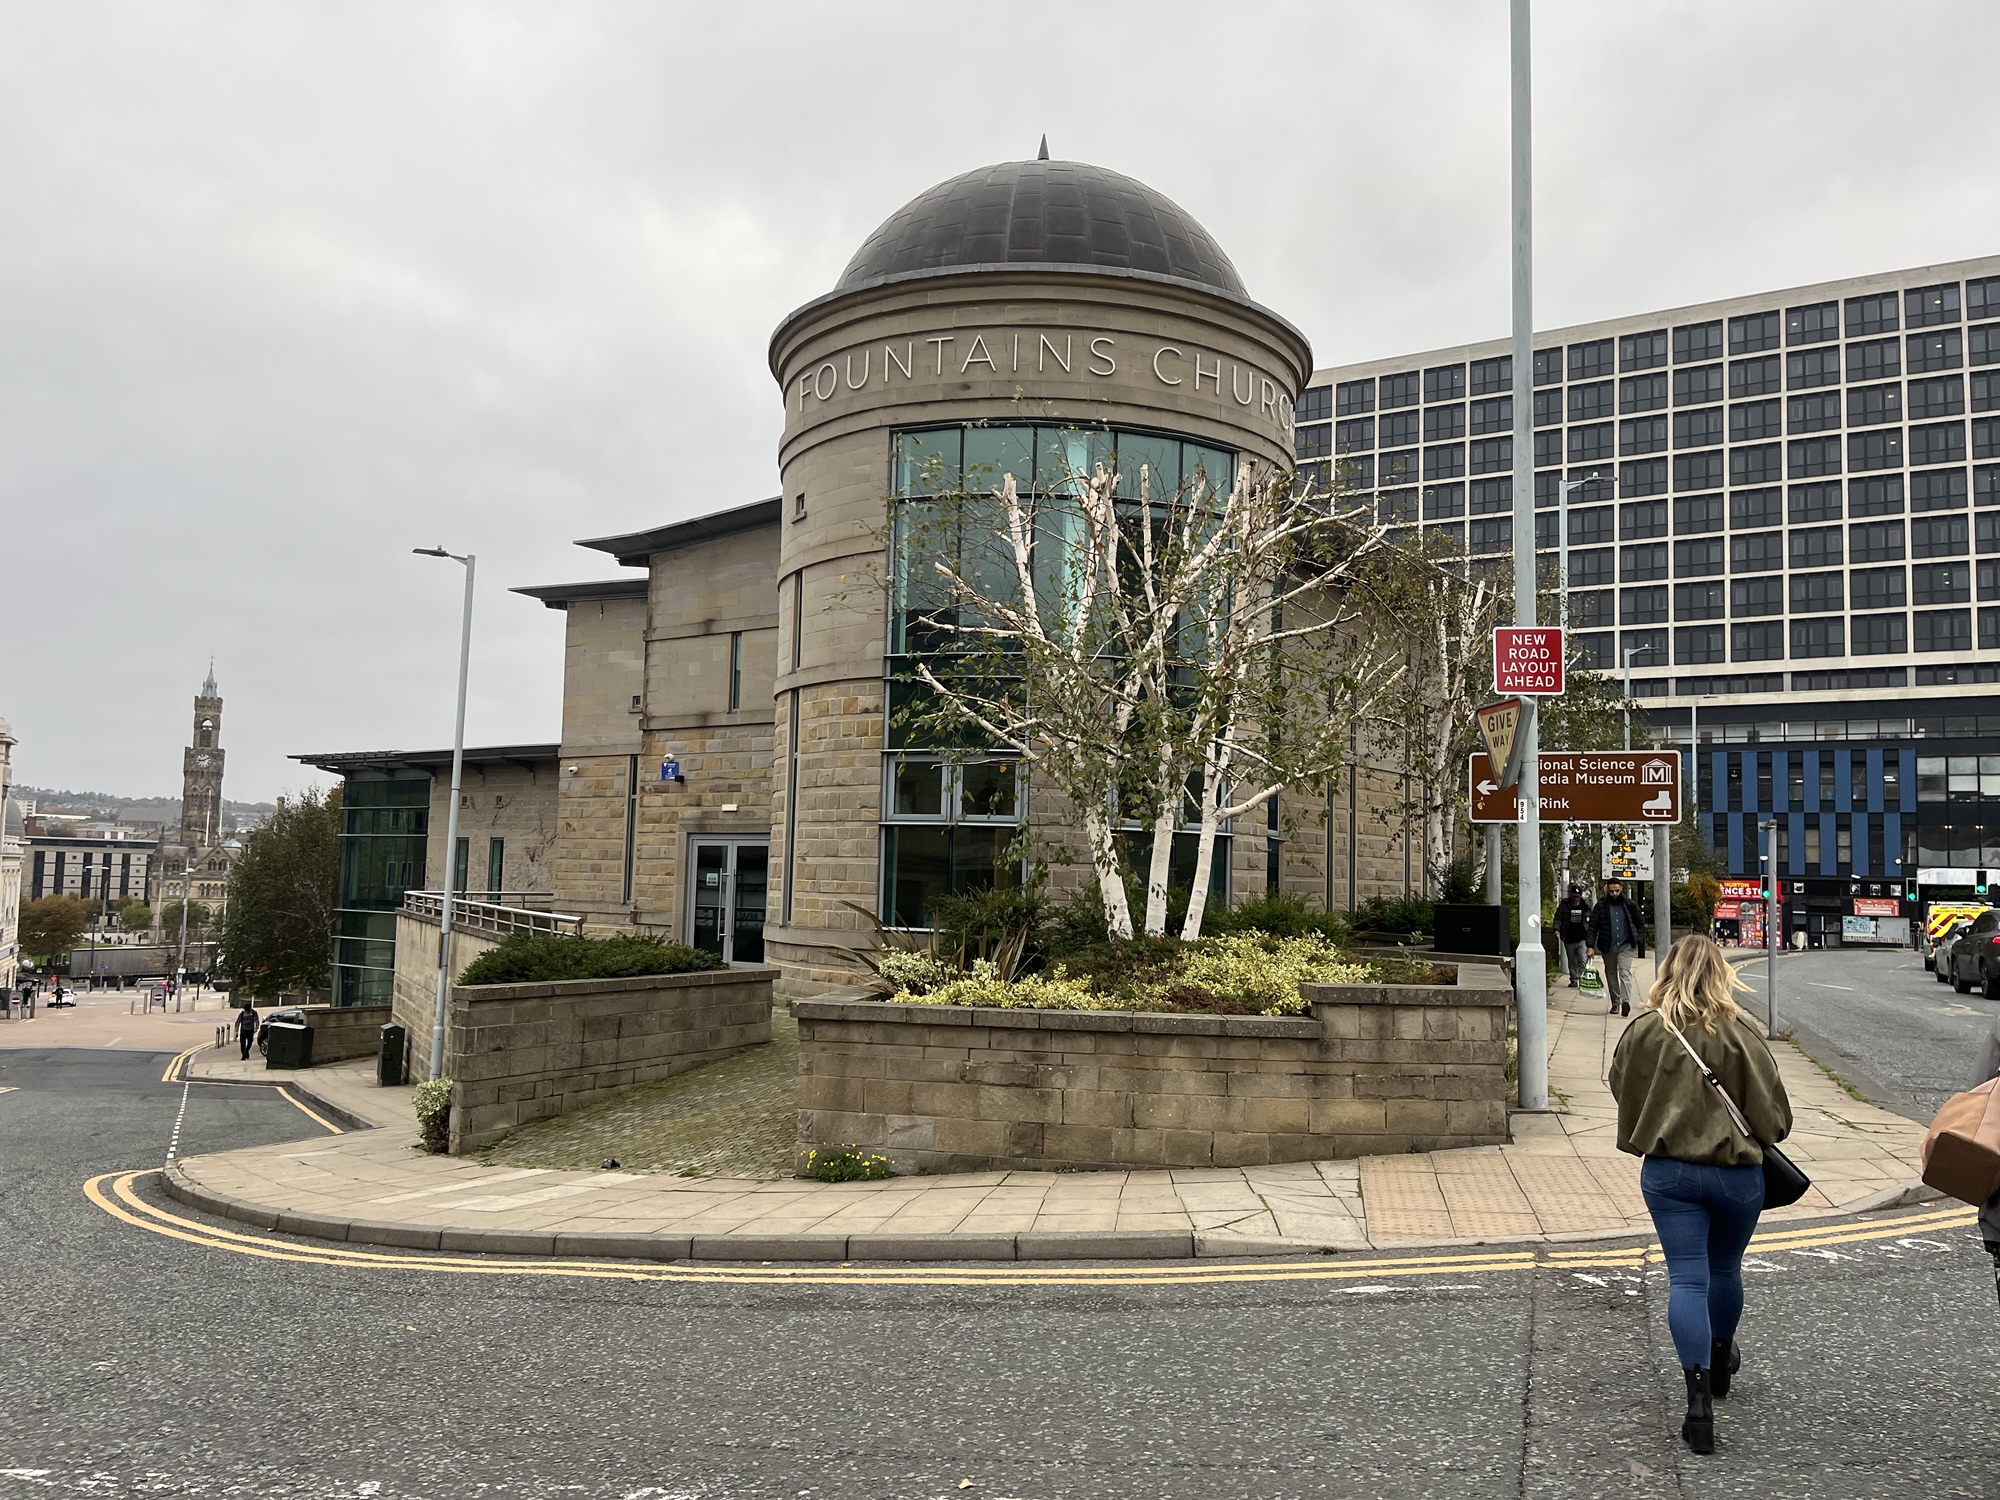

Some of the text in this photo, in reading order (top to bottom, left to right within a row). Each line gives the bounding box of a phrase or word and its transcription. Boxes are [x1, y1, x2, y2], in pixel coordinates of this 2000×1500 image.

[799, 333, 1116, 413] FOUNTAINS
[1512, 634, 1546, 646] NEW
[1508, 648, 1550, 659] ROAD
[1502, 662, 1558, 673] LAYOUT
[1504, 676, 1555, 687] AHEAD
[1487, 711, 1513, 733] GIVE
[1492, 734, 1510, 749] WAY
[1539, 759, 1635, 770] ional Science
[1540, 773, 1635, 785] edia Museum
[1539, 797, 1570, 809] Rink
[1721, 887, 1744, 895] ENCE
